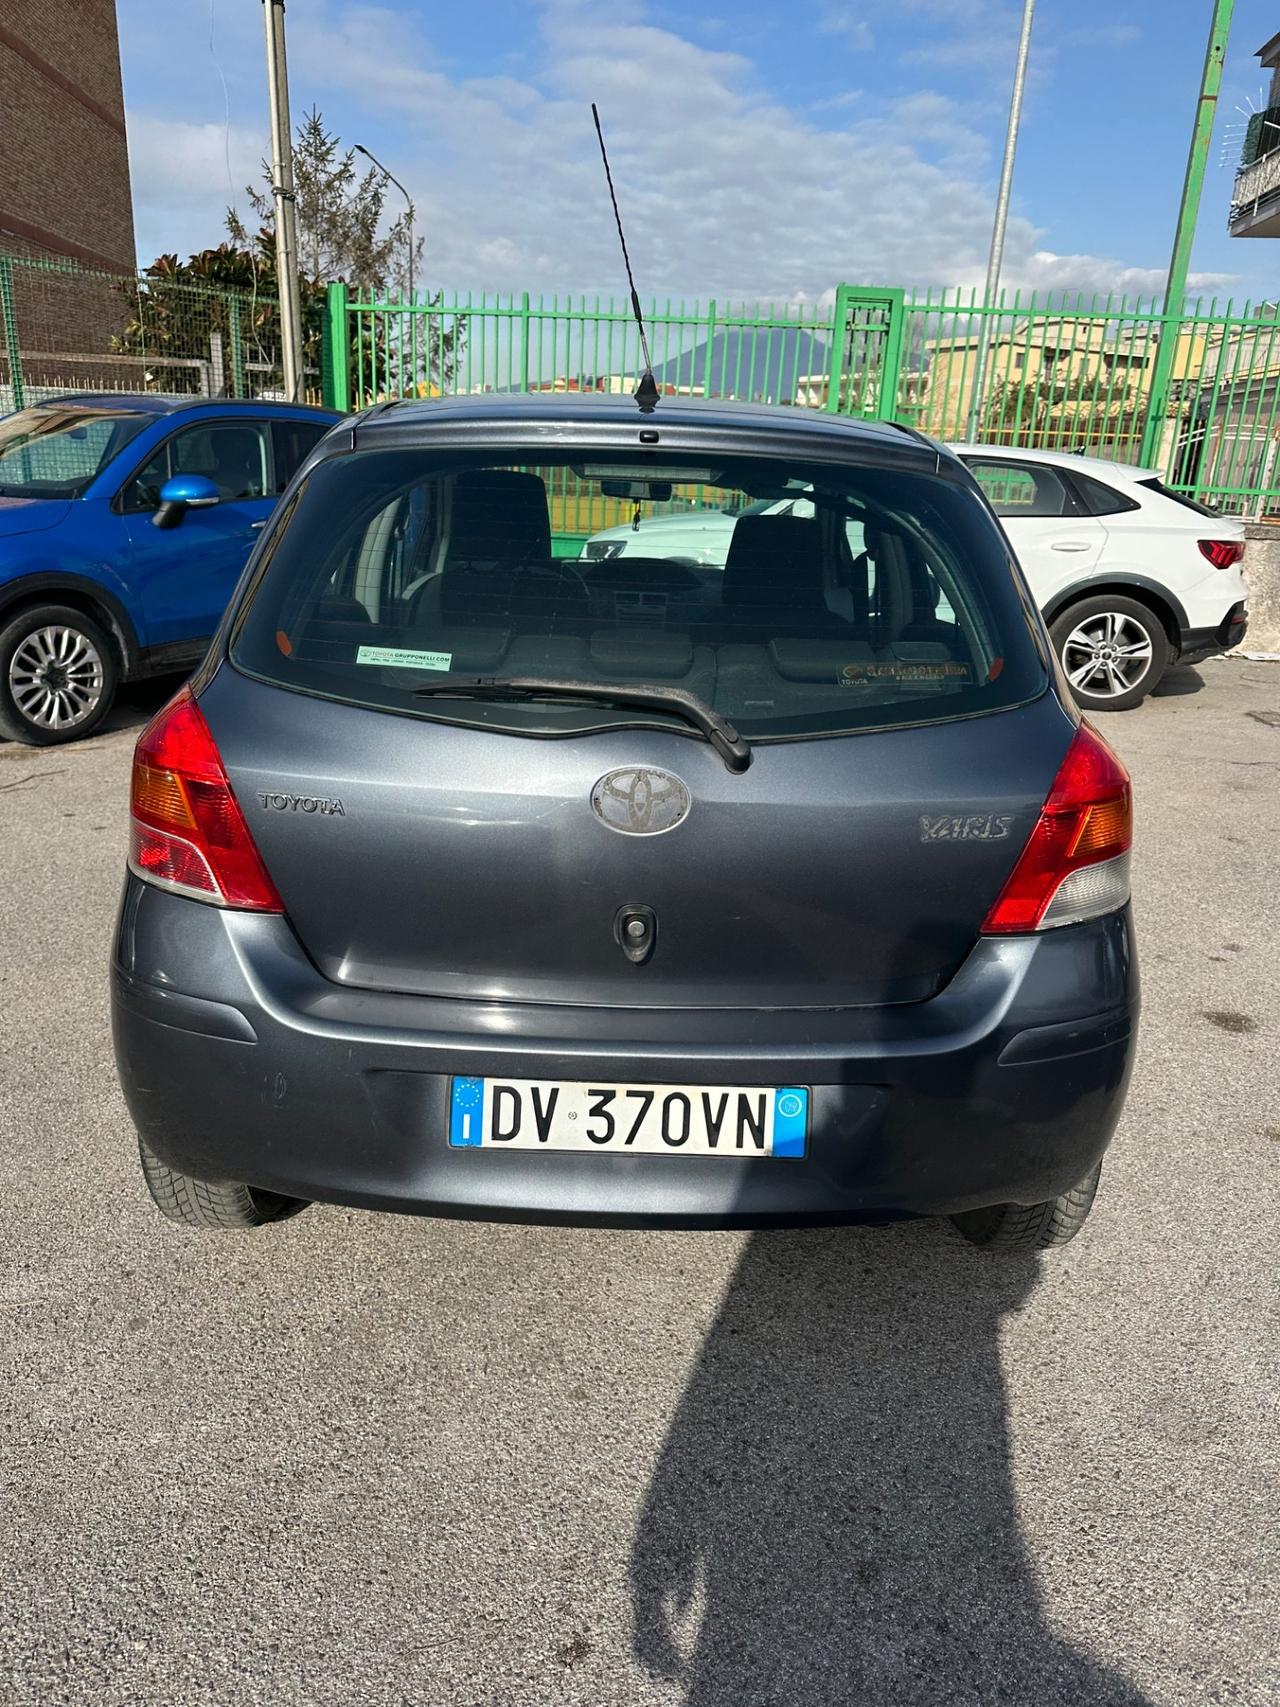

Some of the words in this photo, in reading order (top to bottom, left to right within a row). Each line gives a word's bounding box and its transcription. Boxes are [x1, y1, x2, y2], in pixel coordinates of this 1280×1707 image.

[257, 792, 346, 816] TOYOTA
[920, 815, 1014, 842] YARIS
[491, 1085, 560, 1143] DV
[586, 1089, 767, 1149] 370VN
